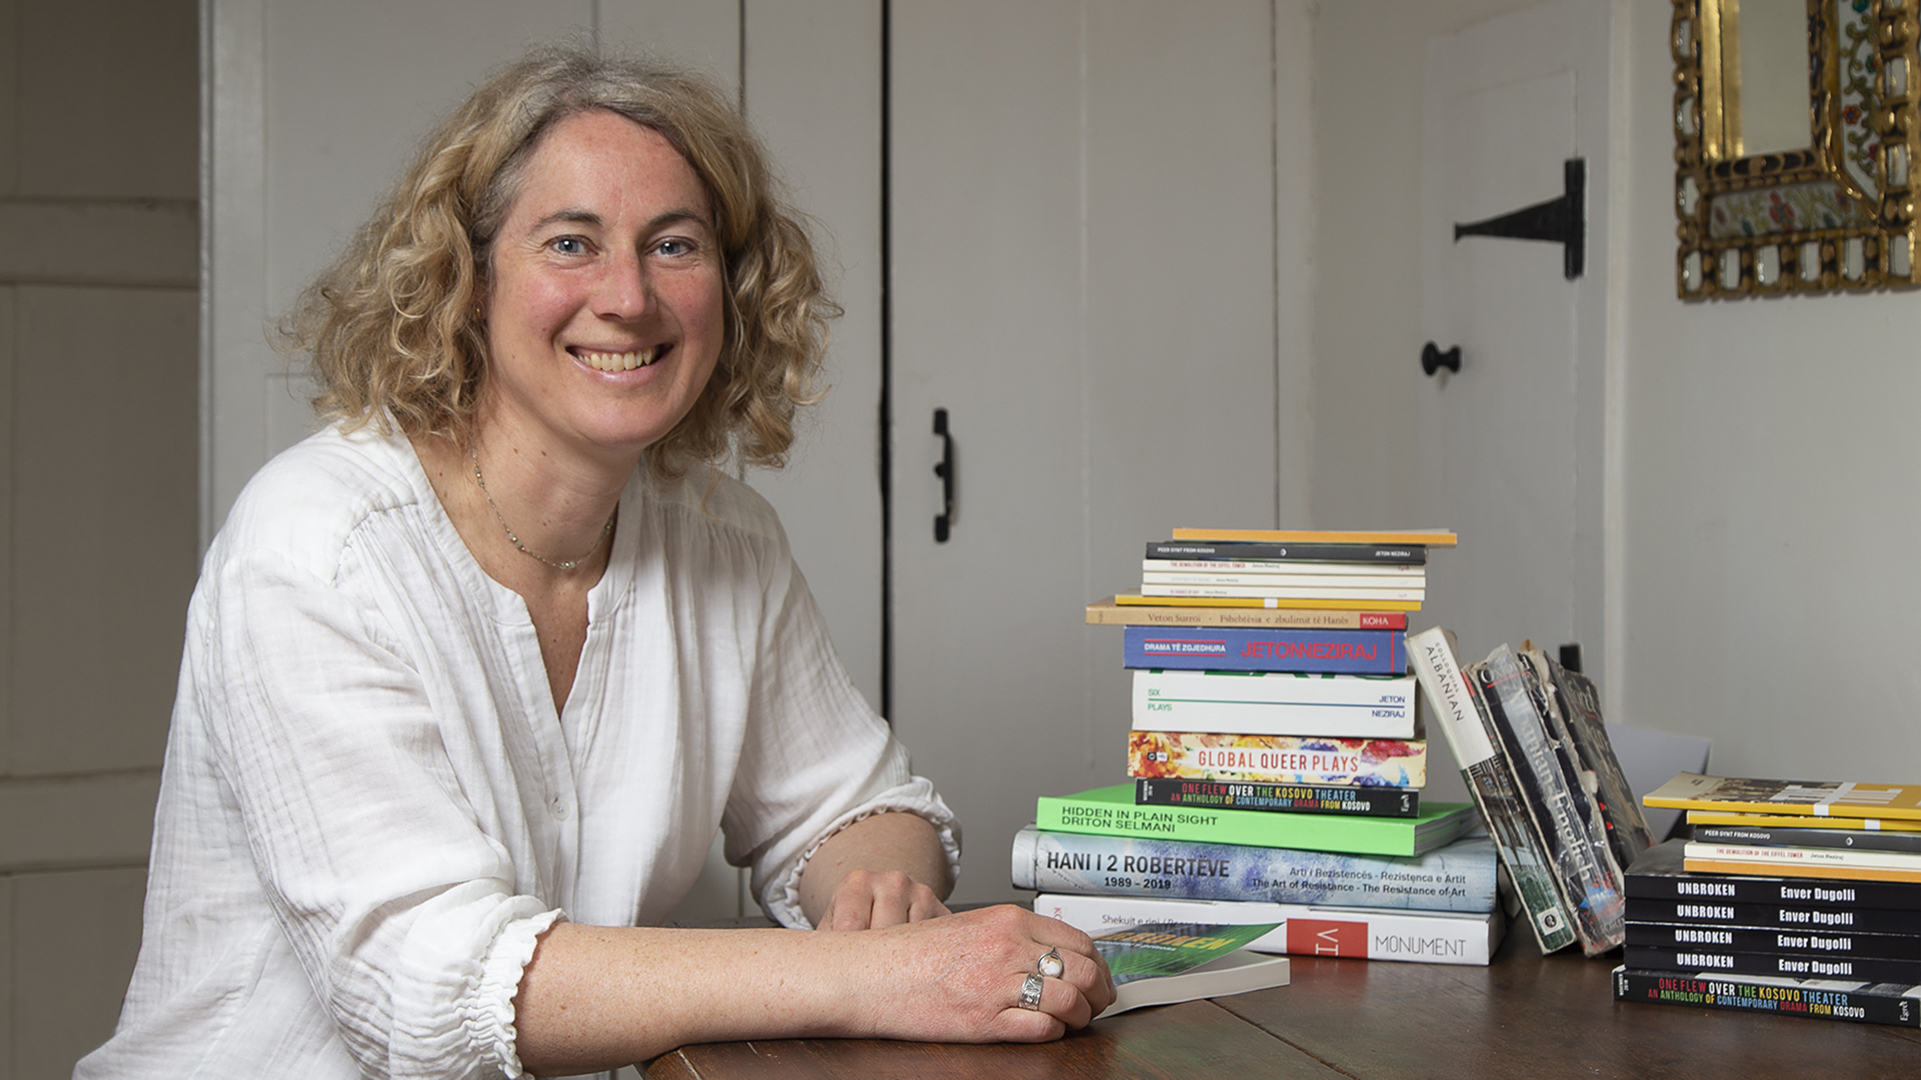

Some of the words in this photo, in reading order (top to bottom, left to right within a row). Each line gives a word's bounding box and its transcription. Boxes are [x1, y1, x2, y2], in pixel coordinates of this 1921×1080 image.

[1148, 614, 1173, 622] Veton
[1175, 614, 1201, 623] Surroi
[1275, 615, 1310, 624] zbulimit
[1362, 616, 1389, 625] KOHA
[1144, 643, 1171, 651] DRAMA
[1172, 642, 1181, 651] TË
[1182, 644, 1226, 652] ZGJEDHURA
[1425, 646, 1465, 722] ALBANIAN
[1148, 704, 1172, 712] PLAYS
[1379, 695, 1405, 703] JETON
[1371, 710, 1405, 719] NEZIRAJ
[1198, 751, 1255, 769] GLOBAL
[1261, 753, 1307, 770] QUEER
[1312, 755, 1359, 772] PLAYS
[1182, 783, 1200, 794] ONE
[1202, 783, 1227, 795] FLEW
[1228, 784, 1254, 796] OVER
[1256, 786, 1273, 798] THE
[1275, 787, 1313, 799] KOSOVO
[1315, 789, 1356, 801] THEATER
[1170, 793, 1181, 801] AN
[1182, 794, 1224, 804] ANTHOLOGY
[1224, 795, 1235, 805] OF
[1235, 796, 1293, 807] CONTEMPORARY
[1294, 798, 1319, 808] DRAMA
[1320, 800, 1341, 810] FROM
[1342, 801, 1371, 812] KOSOVO
[1062, 806, 1113, 818] HIDDEN
[1116, 810, 1130, 819] IN
[1134, 811, 1174, 823] PLAIN
[1177, 814, 1219, 826] SIGHT
[1062, 816, 1112, 828] DRITON
[1115, 819, 1176, 833] SELMANI
[1750, 832, 1771, 840] KOSOVO
[1047, 851, 1091, 871] HANI
[1106, 854, 1118, 872] 2
[1124, 855, 1230, 878] ROBERTËVE
[1104, 877, 1132, 888] 1989
[1290, 867, 1308, 877] Arti
[1445, 873, 1466, 884] Artit
[1252, 878, 1270, 888] The
[1272, 879, 1287, 889] Art
[1288, 879, 1299, 889] of
[1302, 881, 1355, 892] Resistance
[1362, 883, 1380, 893] The
[1383, 885, 1436, 896] Resistance
[1438, 887, 1449, 896] of
[1451, 887, 1466, 897] Art
[1677, 882, 1736, 897] UNBROKEN
[1780, 886, 1812, 900] Enver
[1814, 887, 1855, 902] Dugolli
[1102, 914, 1135, 925] Shekujt
[1677, 905, 1735, 919] UNBROKEN
[1779, 909, 1810, 923] Enver
[1813, 911, 1853, 925] Dugolli
[1376, 935, 1467, 957] MONUMENT
[1675, 929, 1733, 944] UNBROKEN
[1777, 934, 1808, 948] Enver
[1811, 936, 1852, 950] Dugolli
[1677, 953, 1734, 968] UNBROKEN
[1778, 959, 1809, 972] Enver
[1812, 960, 1852, 975] Dugolli
[1659, 978, 1678, 991] ONE
[1680, 980, 1706, 993] FLEW
[1708, 982, 1735, 996] OVER
[1738, 985, 1757, 998] THE
[1759, 987, 1800, 1002] KOSOVO
[1802, 991, 1848, 1006] THEATER
[1648, 988, 1659, 998] AN
[1660, 990, 1704, 1003] ANTHOLOGY
[1705, 994, 1715, 1004] OF
[1717, 995, 1778, 1010] CONTEMPORARY
[1780, 1001, 1808, 1013] DRAMA
[1809, 1003, 1832, 1015] FROM
[1833, 1005, 1865, 1018] KOSOVO
